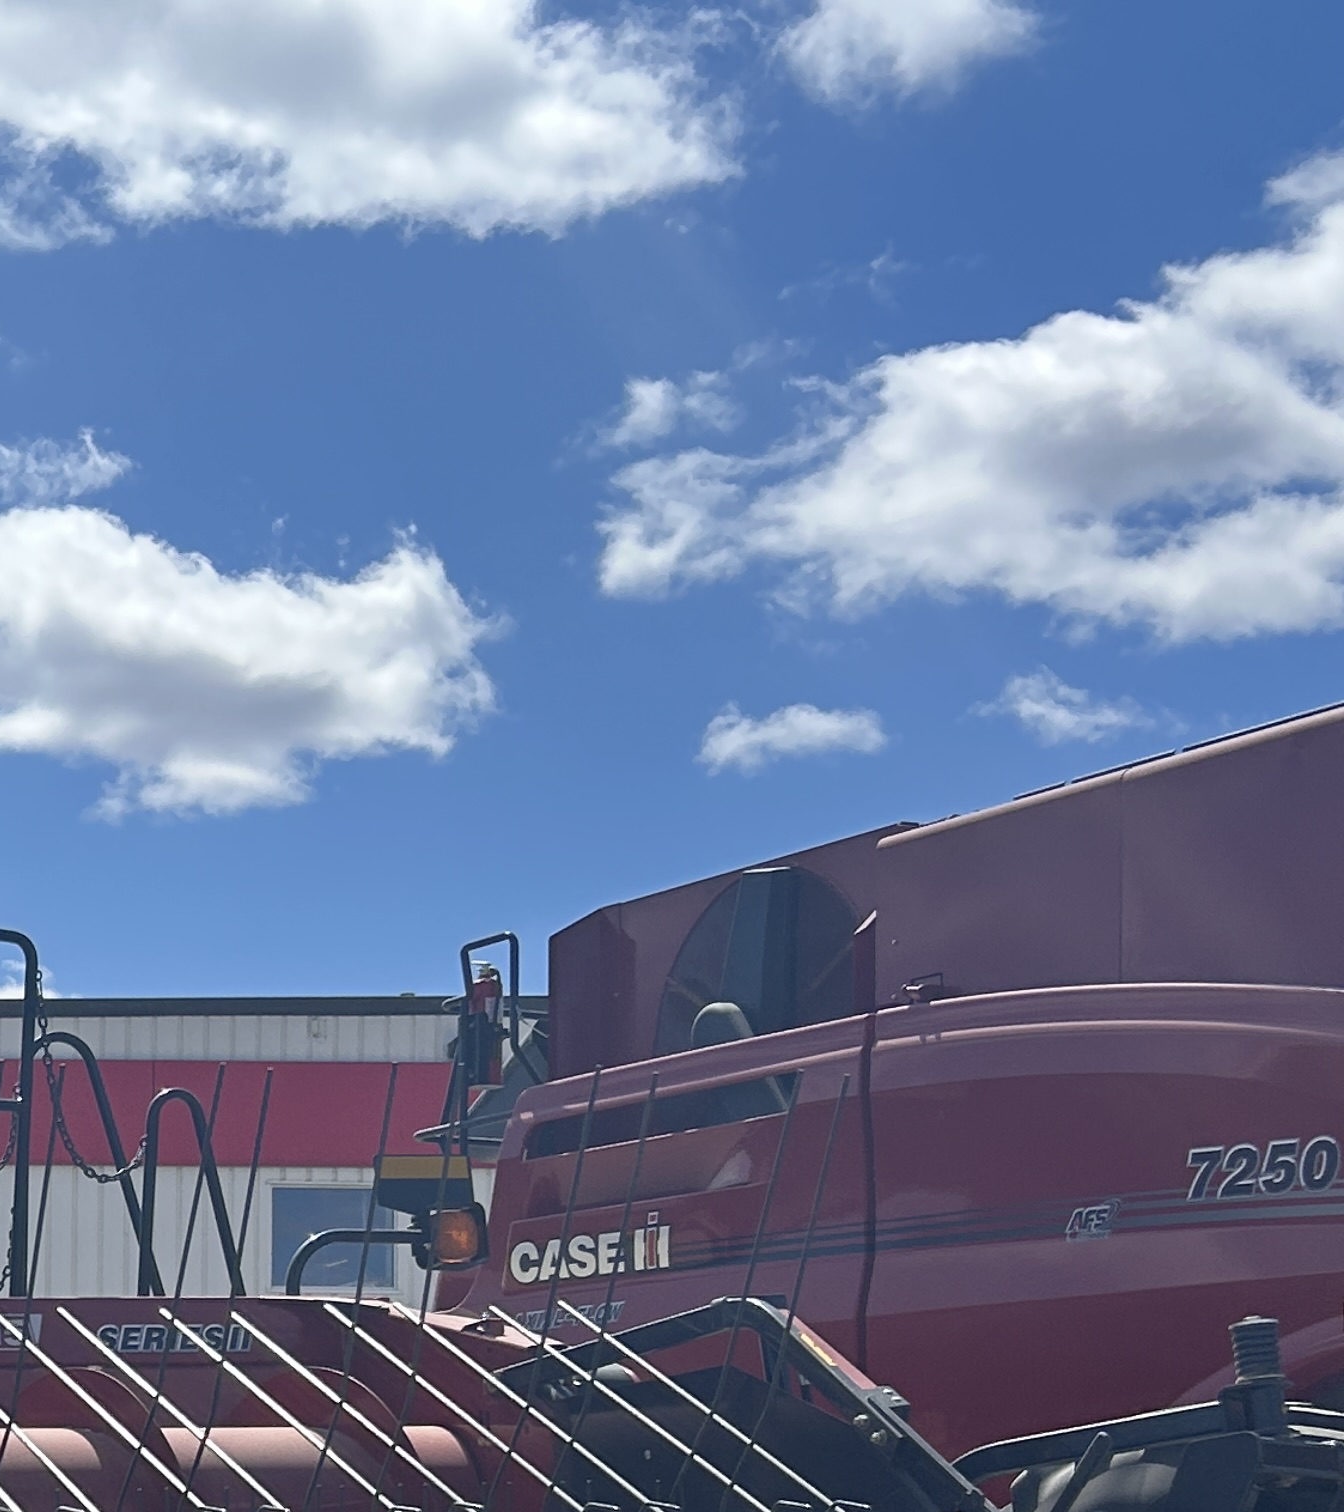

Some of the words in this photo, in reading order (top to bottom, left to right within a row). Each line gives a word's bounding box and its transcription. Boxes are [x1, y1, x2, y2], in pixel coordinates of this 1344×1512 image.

[1185, 1135, 1340, 1201] 7250
[510, 1231, 626, 1284] CASE
[634, 1211, 671, 1271] IH
